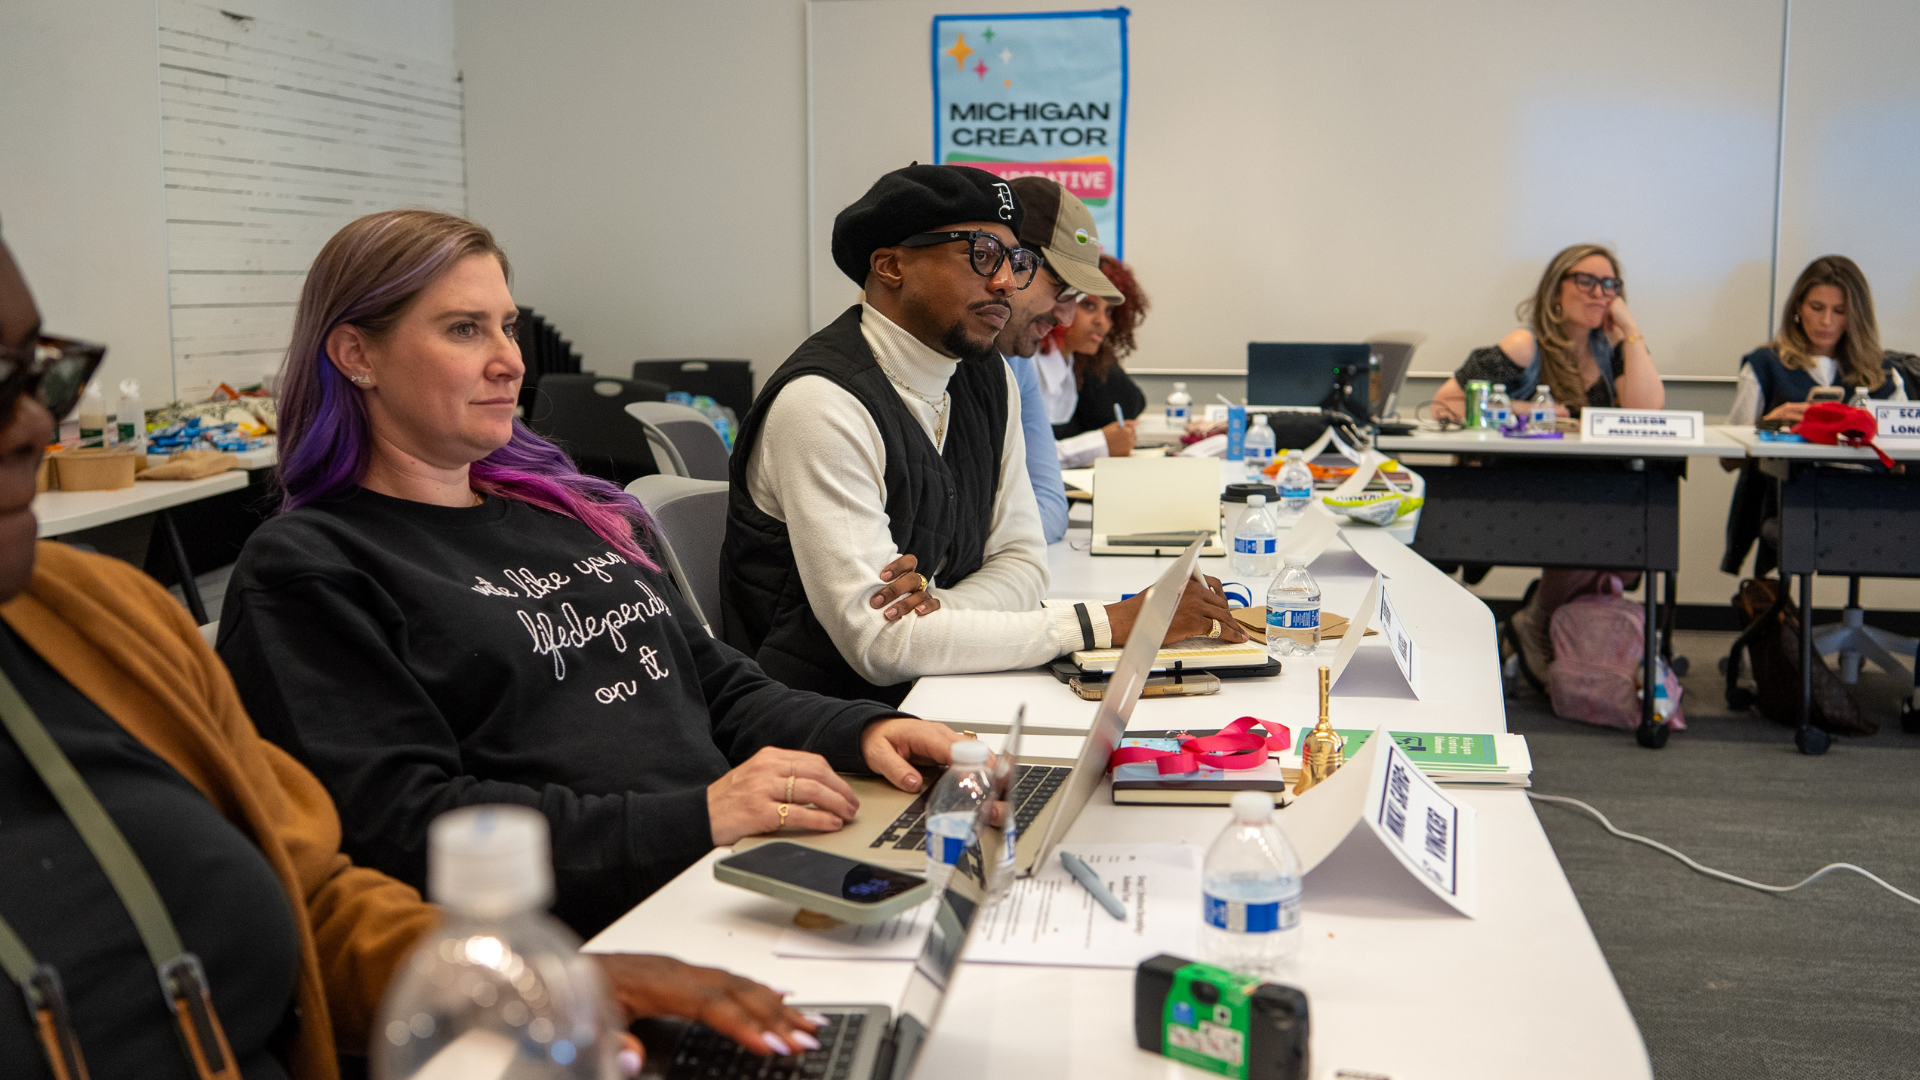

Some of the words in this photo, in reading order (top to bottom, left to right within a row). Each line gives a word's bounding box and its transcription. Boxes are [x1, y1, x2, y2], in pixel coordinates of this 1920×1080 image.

[951, 103, 1109, 121] MICHIGAN
[952, 127, 1107, 146] CREATOR
[504, 568, 571, 599] like
[517, 610, 571, 681] life
[595, 680, 637, 704] on
[639, 646, 669, 680] it
